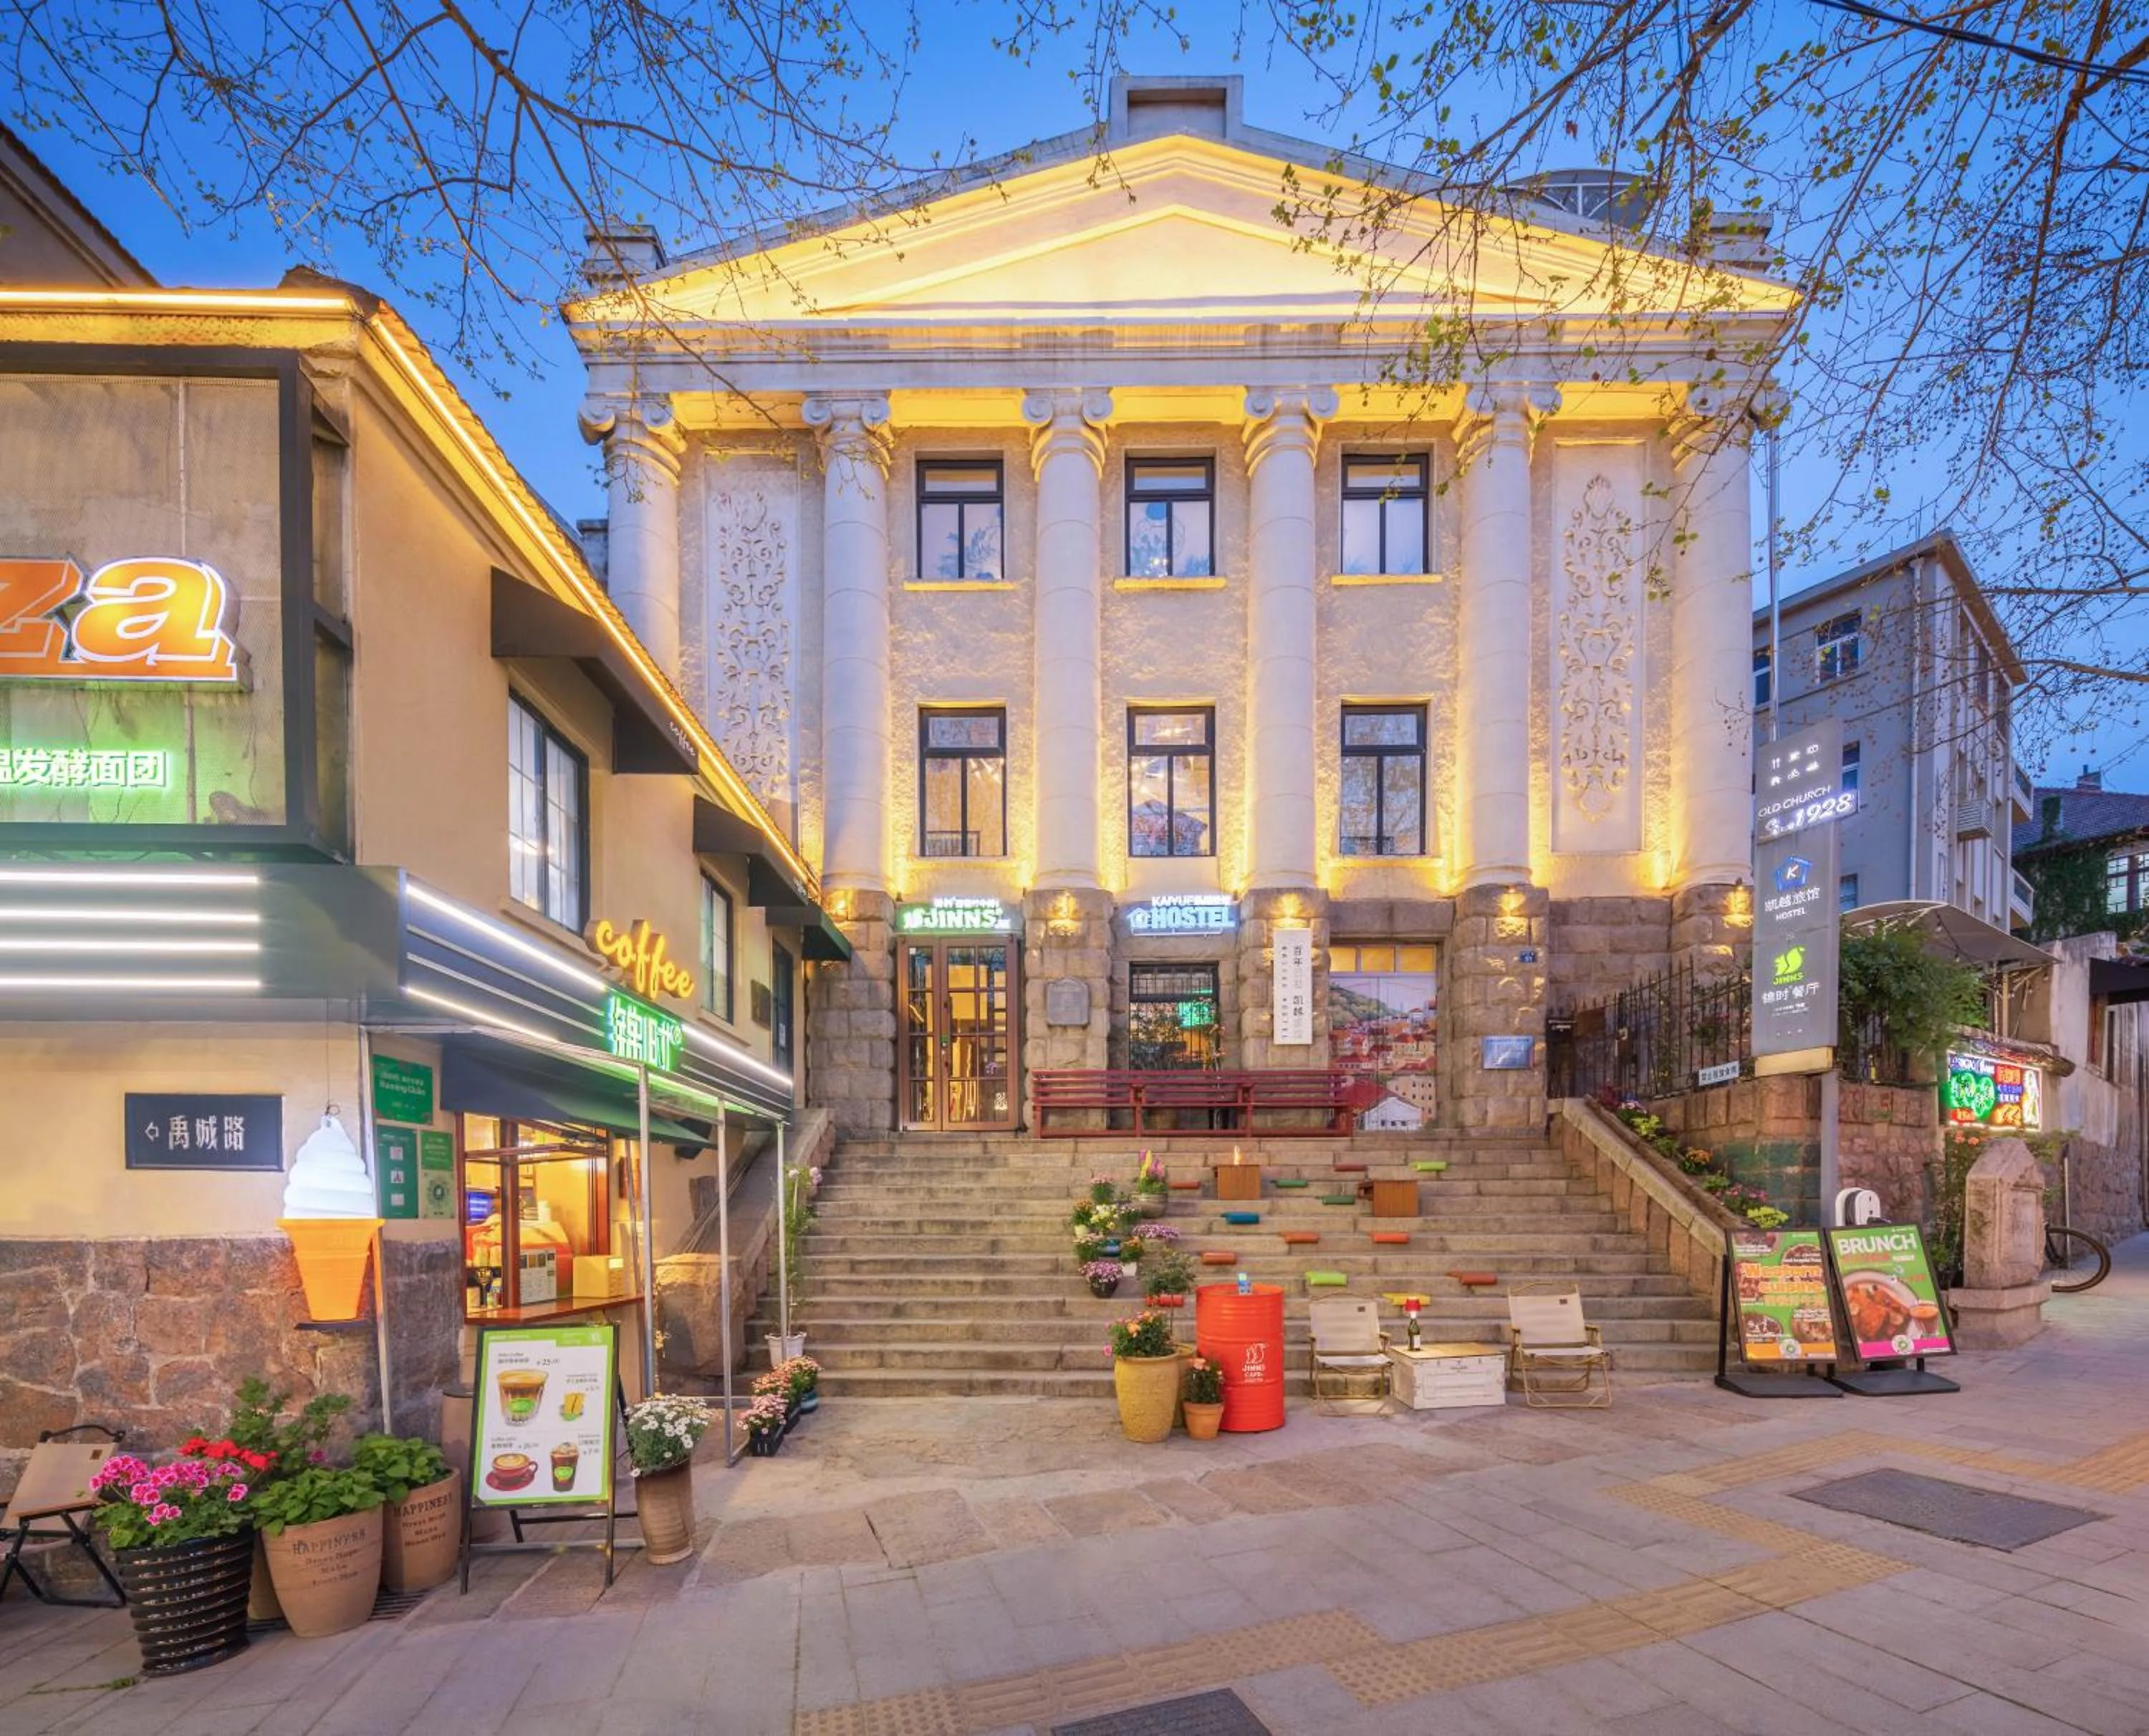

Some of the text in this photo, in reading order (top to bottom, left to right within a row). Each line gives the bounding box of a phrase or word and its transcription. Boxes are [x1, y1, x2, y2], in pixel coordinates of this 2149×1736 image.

[1757, 784, 1832, 818] OLD CHURCH
[923, 907, 996, 929] JINNS
[1150, 907, 1236, 929] HOSTEL
[1776, 907, 1805, 921] HOSTEL
[595, 920, 695, 1000] coffee
[168, 1114, 246, 1152] 禹城路
[1837, 1233, 1918, 1255] BRUNCH
